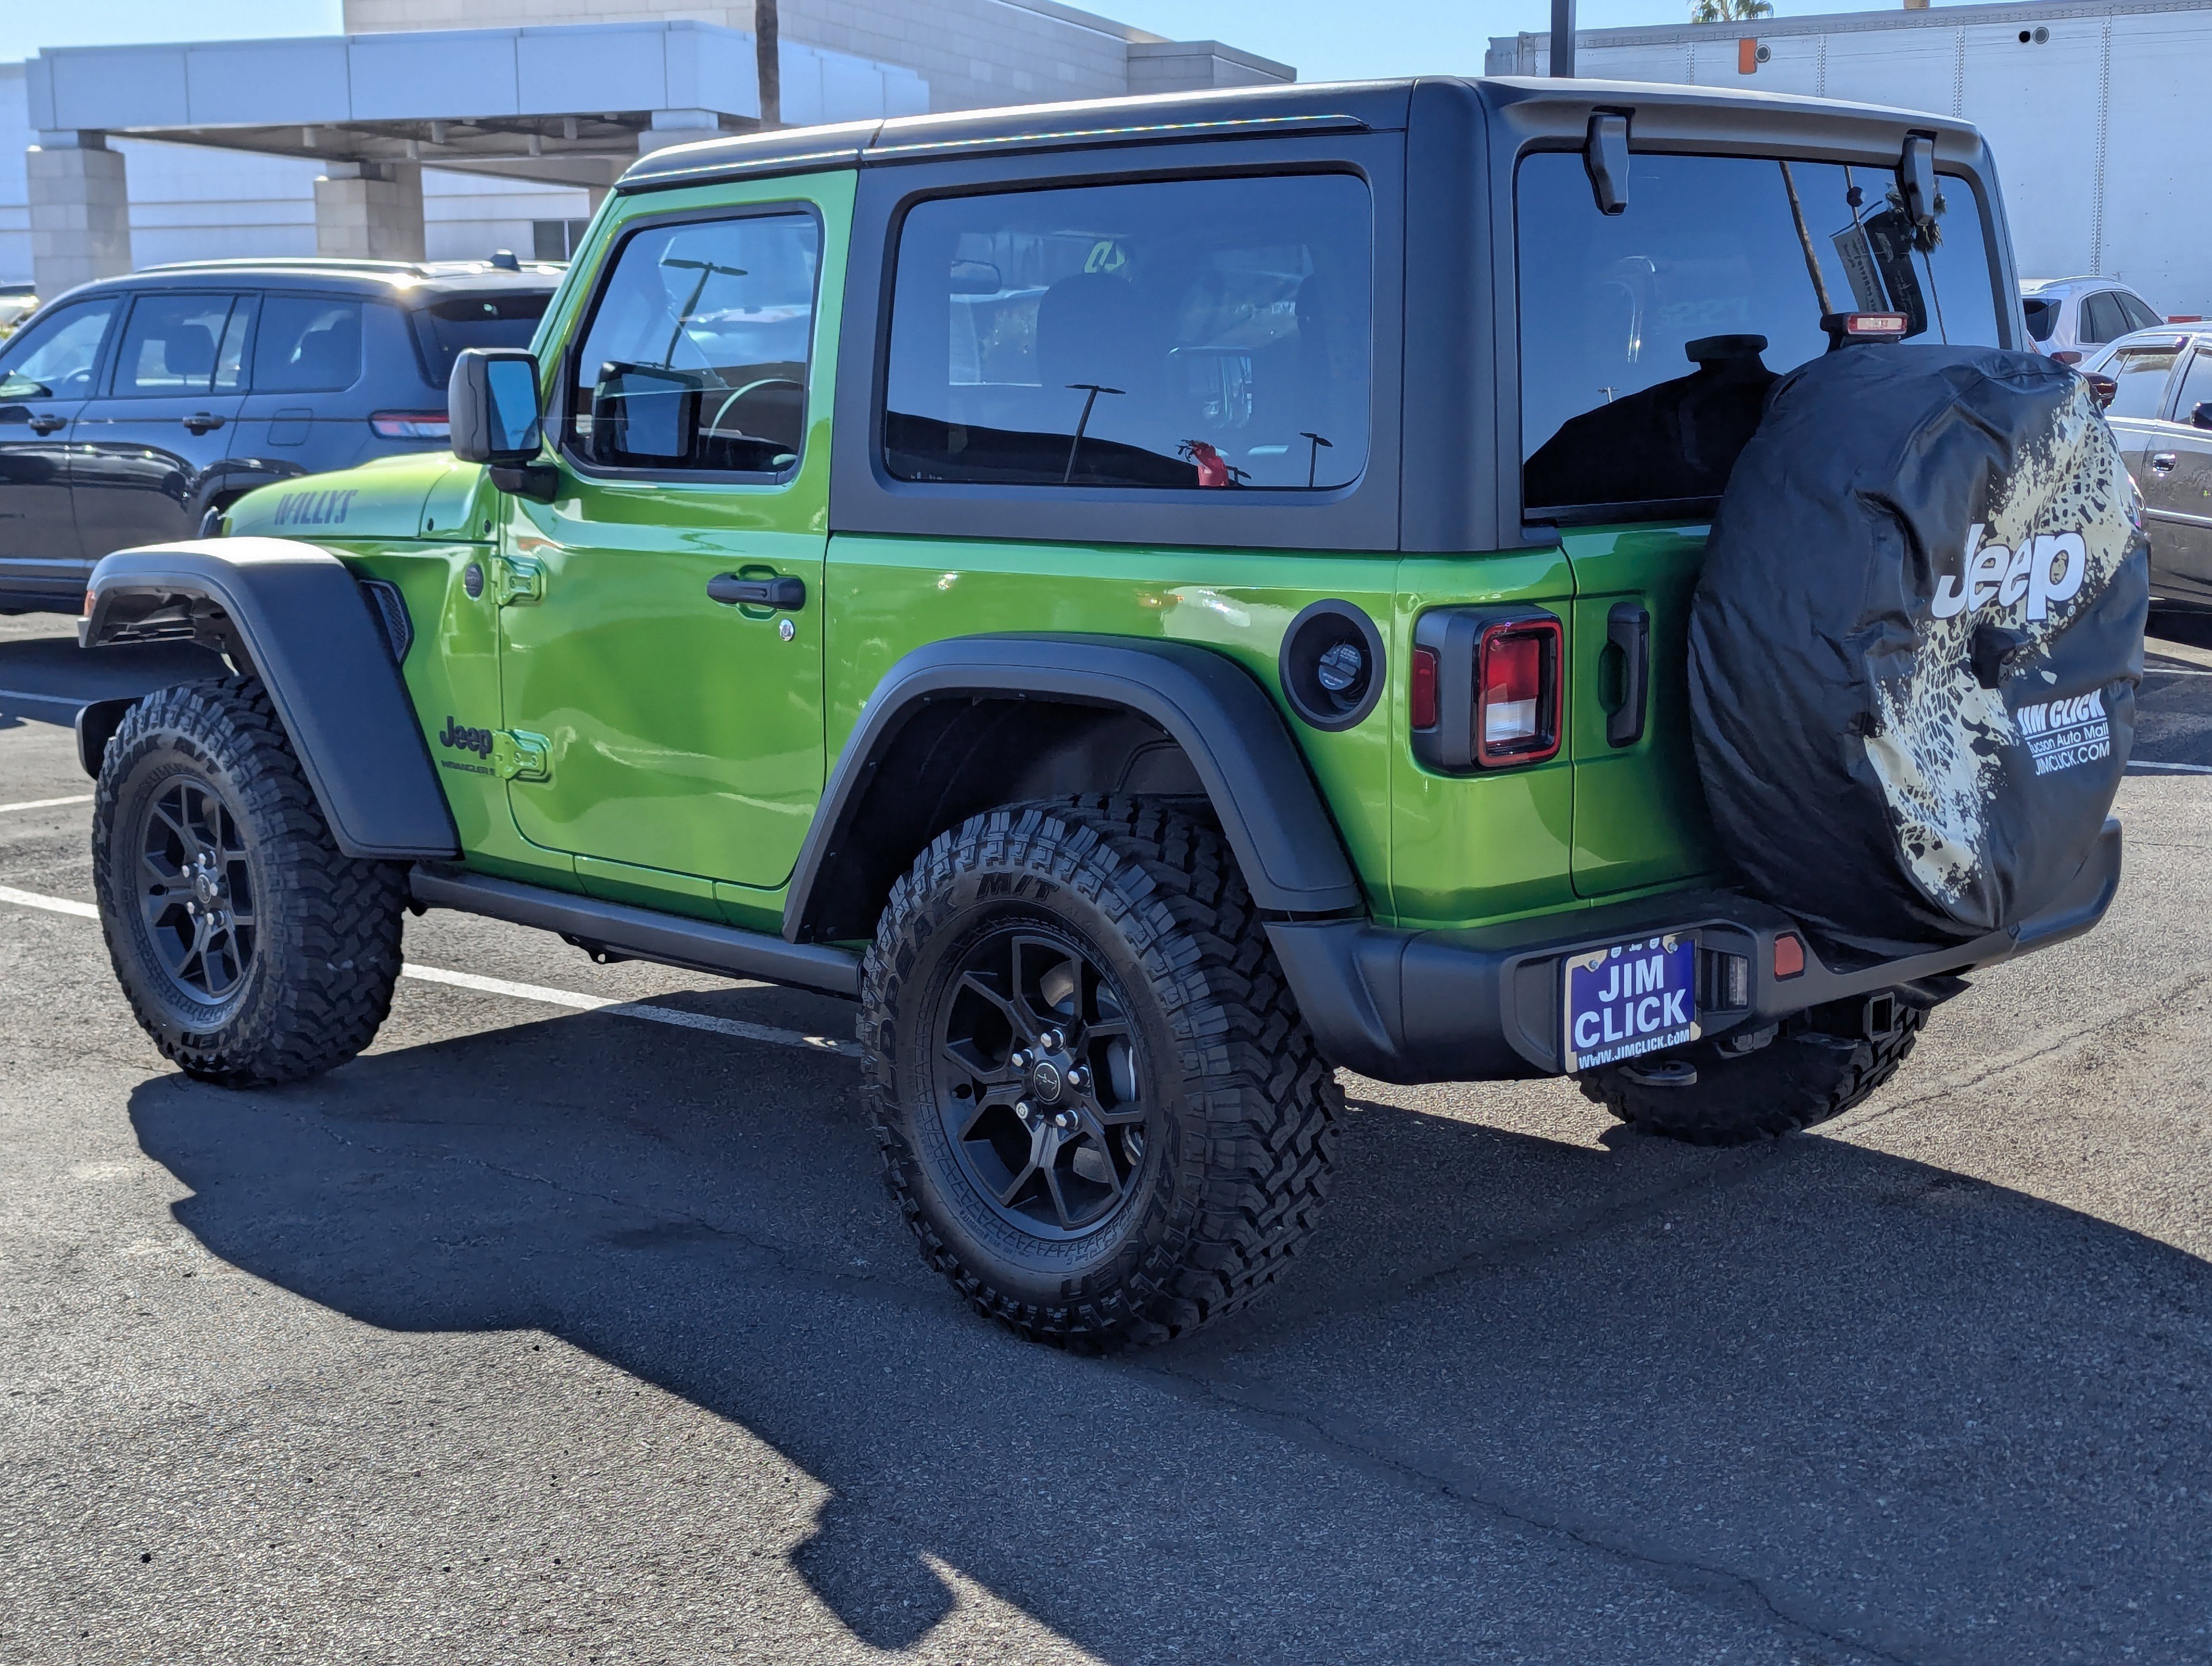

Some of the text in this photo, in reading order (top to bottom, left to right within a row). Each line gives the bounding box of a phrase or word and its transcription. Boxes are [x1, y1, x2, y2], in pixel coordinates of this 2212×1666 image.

[274, 490, 358, 525] WILLYS
[1931, 523, 2086, 620] Jeep
[2017, 688, 2106, 735] JIM CLICK
[439, 716, 493, 759] Jeep
[2027, 722, 2108, 754] Tucson Auto Mall
[2036, 741, 2110, 776] JIMCLICK.COM
[975, 872, 1060, 901] M/T
[1598, 954, 1664, 1002] JIM
[1575, 989, 1687, 1048] CLICK
[1579, 1029, 1689, 1069] WWW.JIMCLICK.COM
